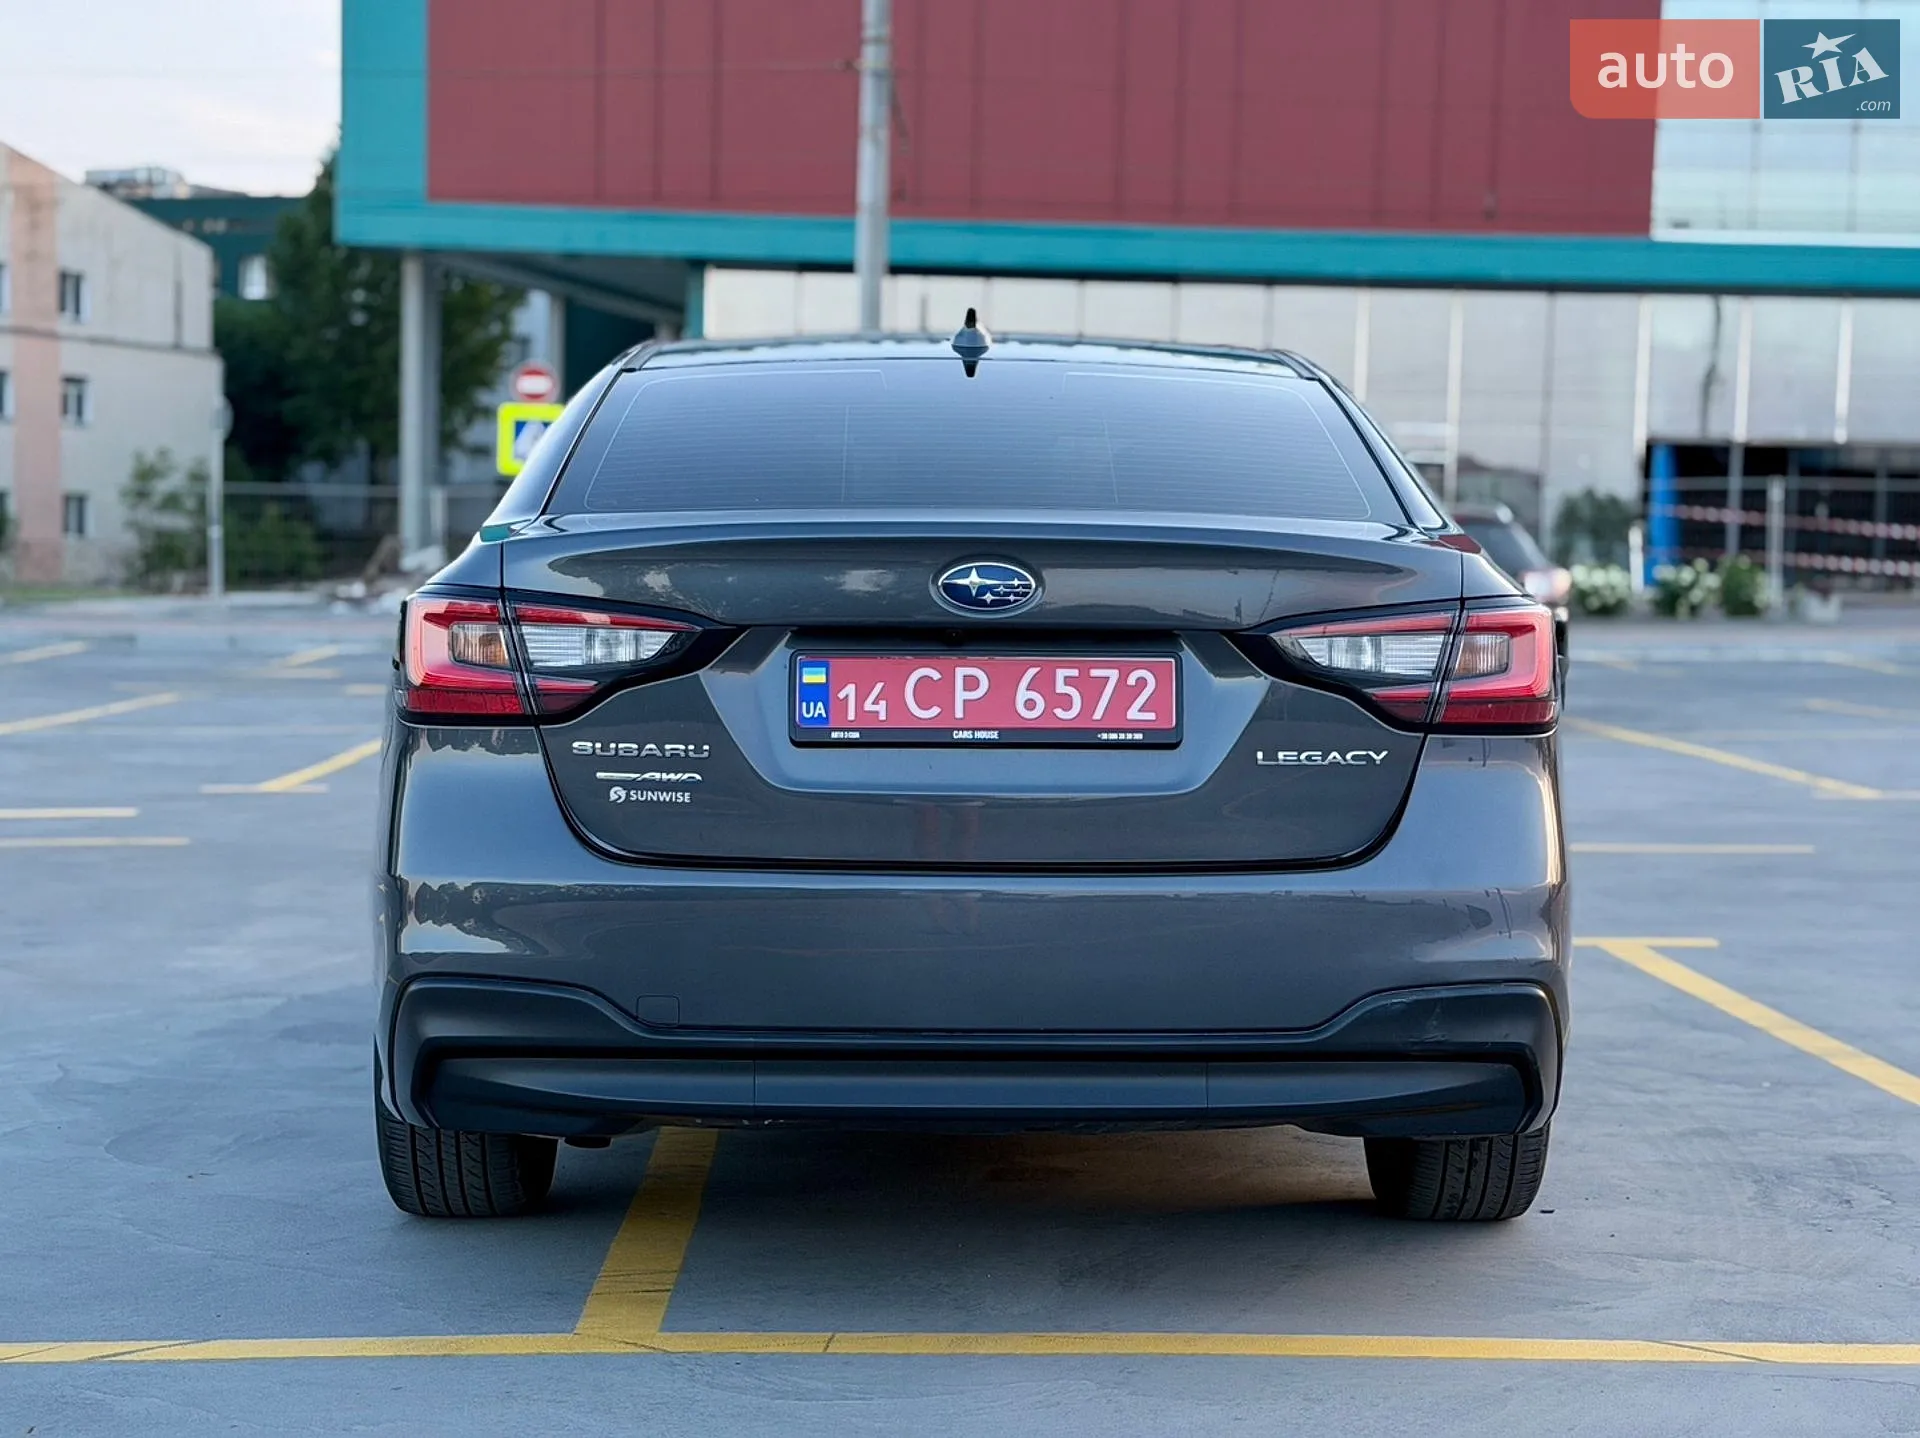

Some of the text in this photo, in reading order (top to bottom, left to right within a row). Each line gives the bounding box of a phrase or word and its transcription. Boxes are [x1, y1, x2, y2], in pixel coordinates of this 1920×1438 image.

[836, 666, 1157, 721] 14 CP 6572
[802, 701, 827, 718] UA
[571, 741, 711, 758] SUBARU
[1256, 750, 1389, 765] LEGACY
[629, 789, 692, 803] SUNWISE
